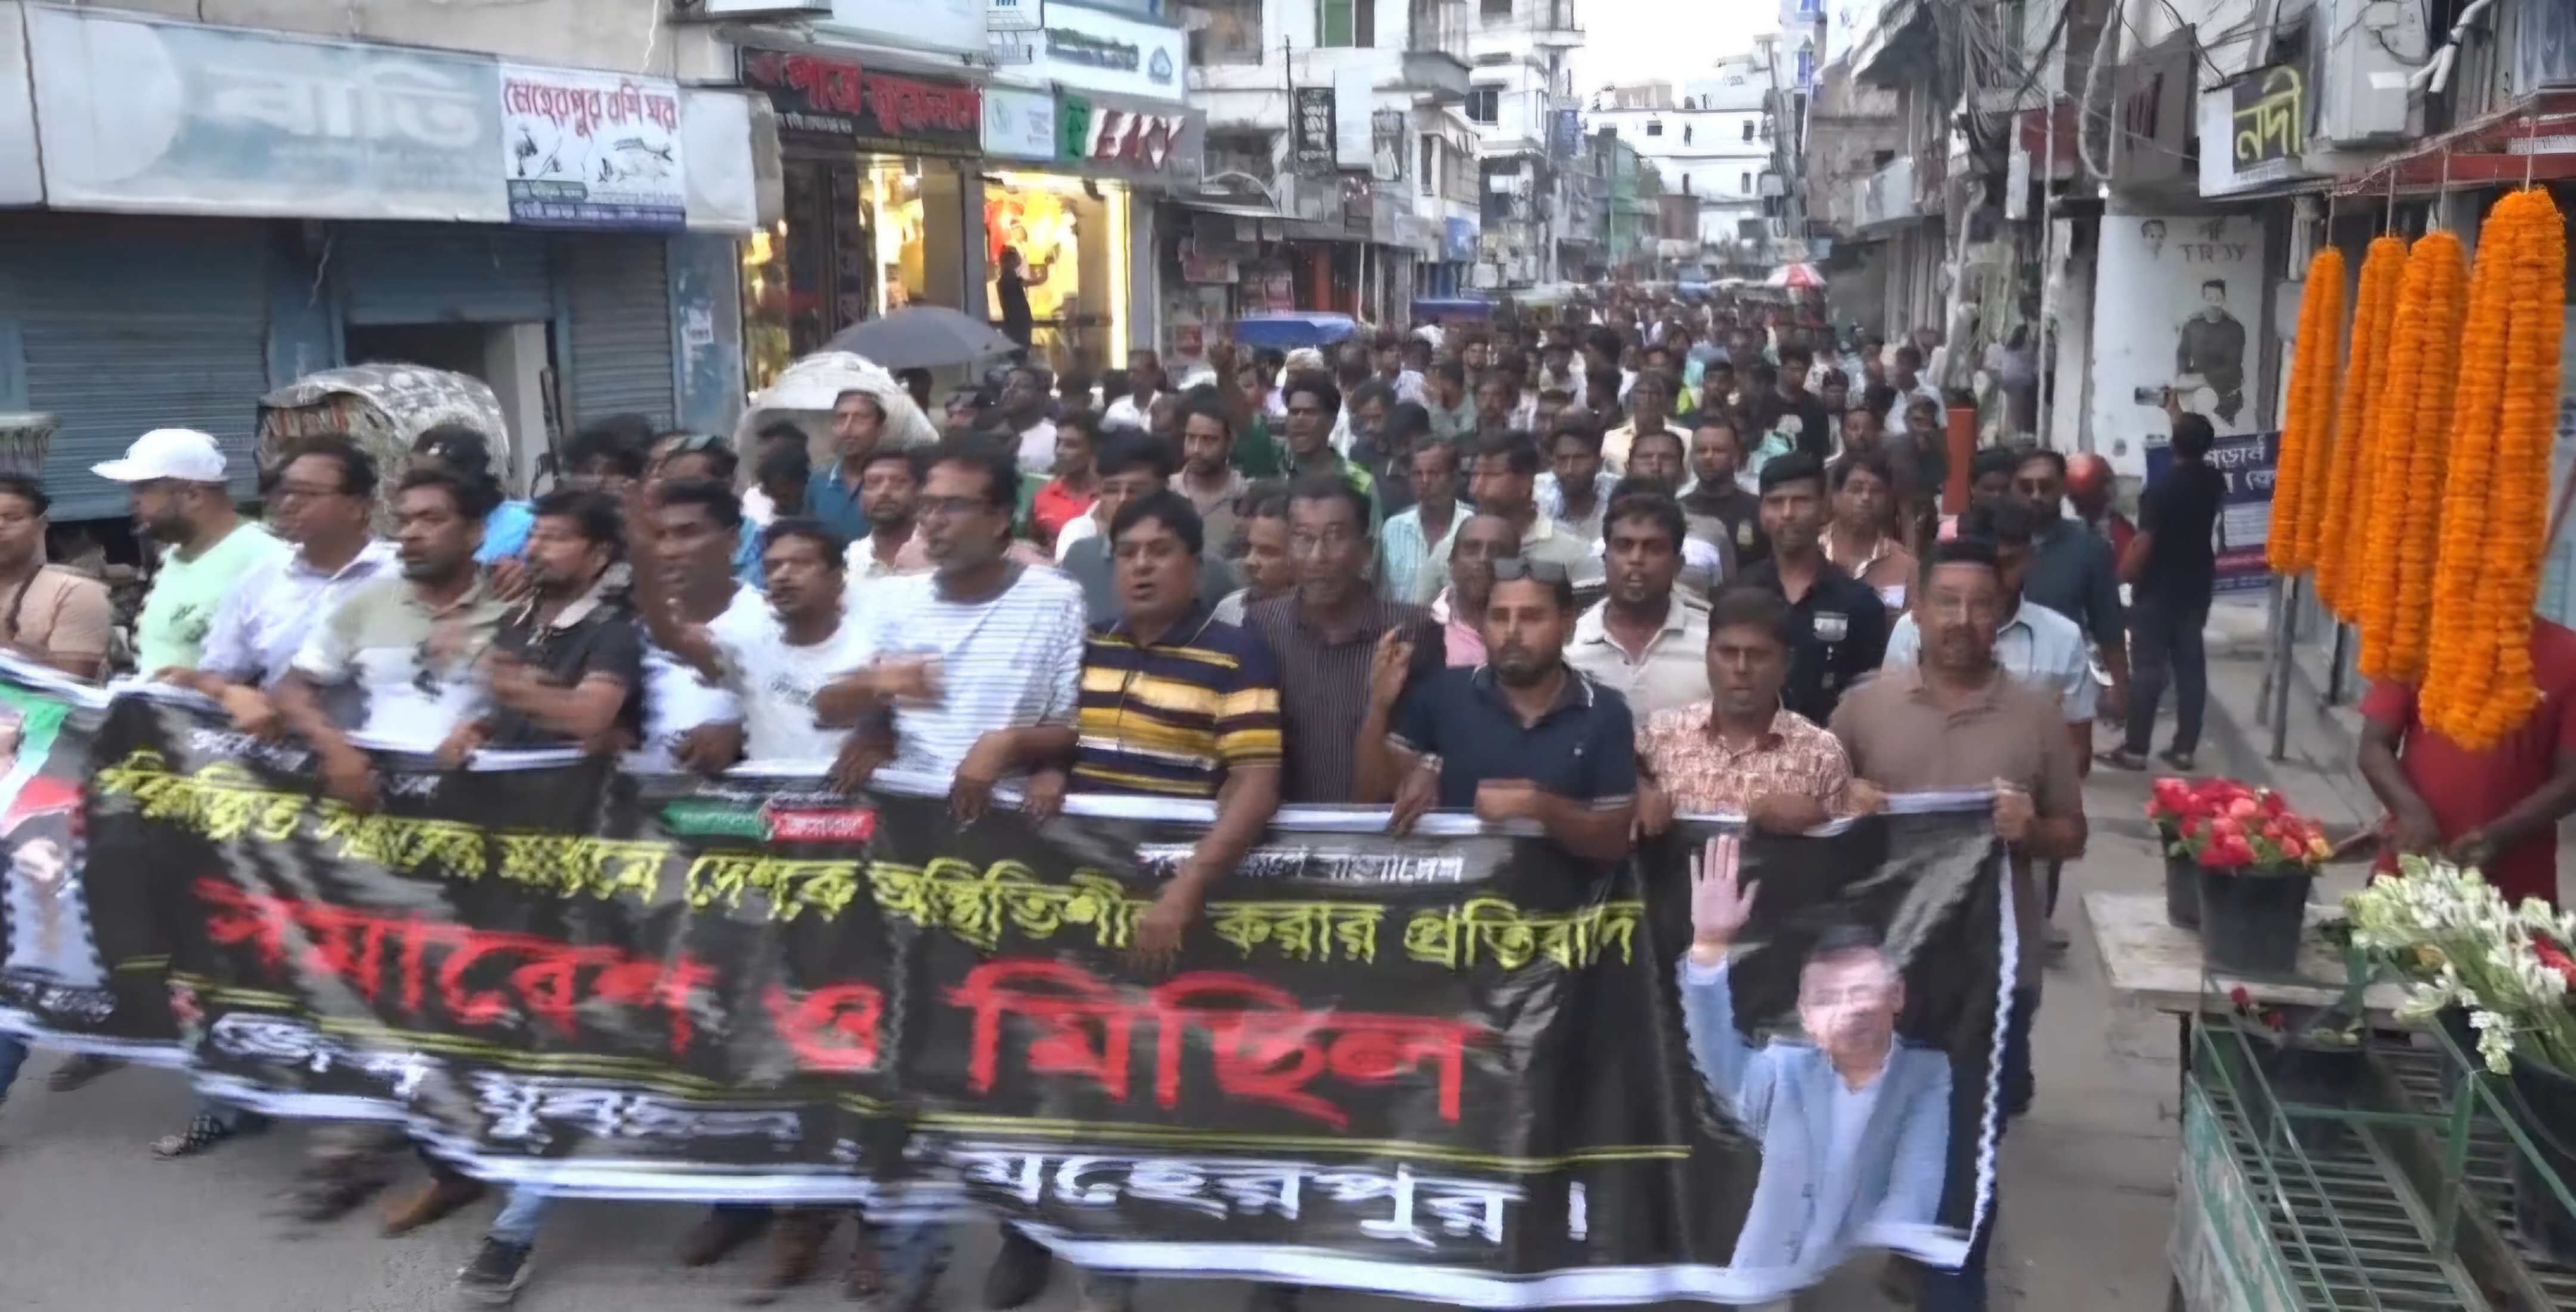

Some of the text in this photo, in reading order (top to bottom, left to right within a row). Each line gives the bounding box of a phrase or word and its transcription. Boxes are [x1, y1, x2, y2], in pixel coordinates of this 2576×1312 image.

[2234, 64, 2302, 160] নদী
[866, 858, 1183, 957] অস্থিতিশী
[1203, 899, 1388, 965] করার
[196, 877, 1494, 1131] সমাবেশ ও মিছিল
